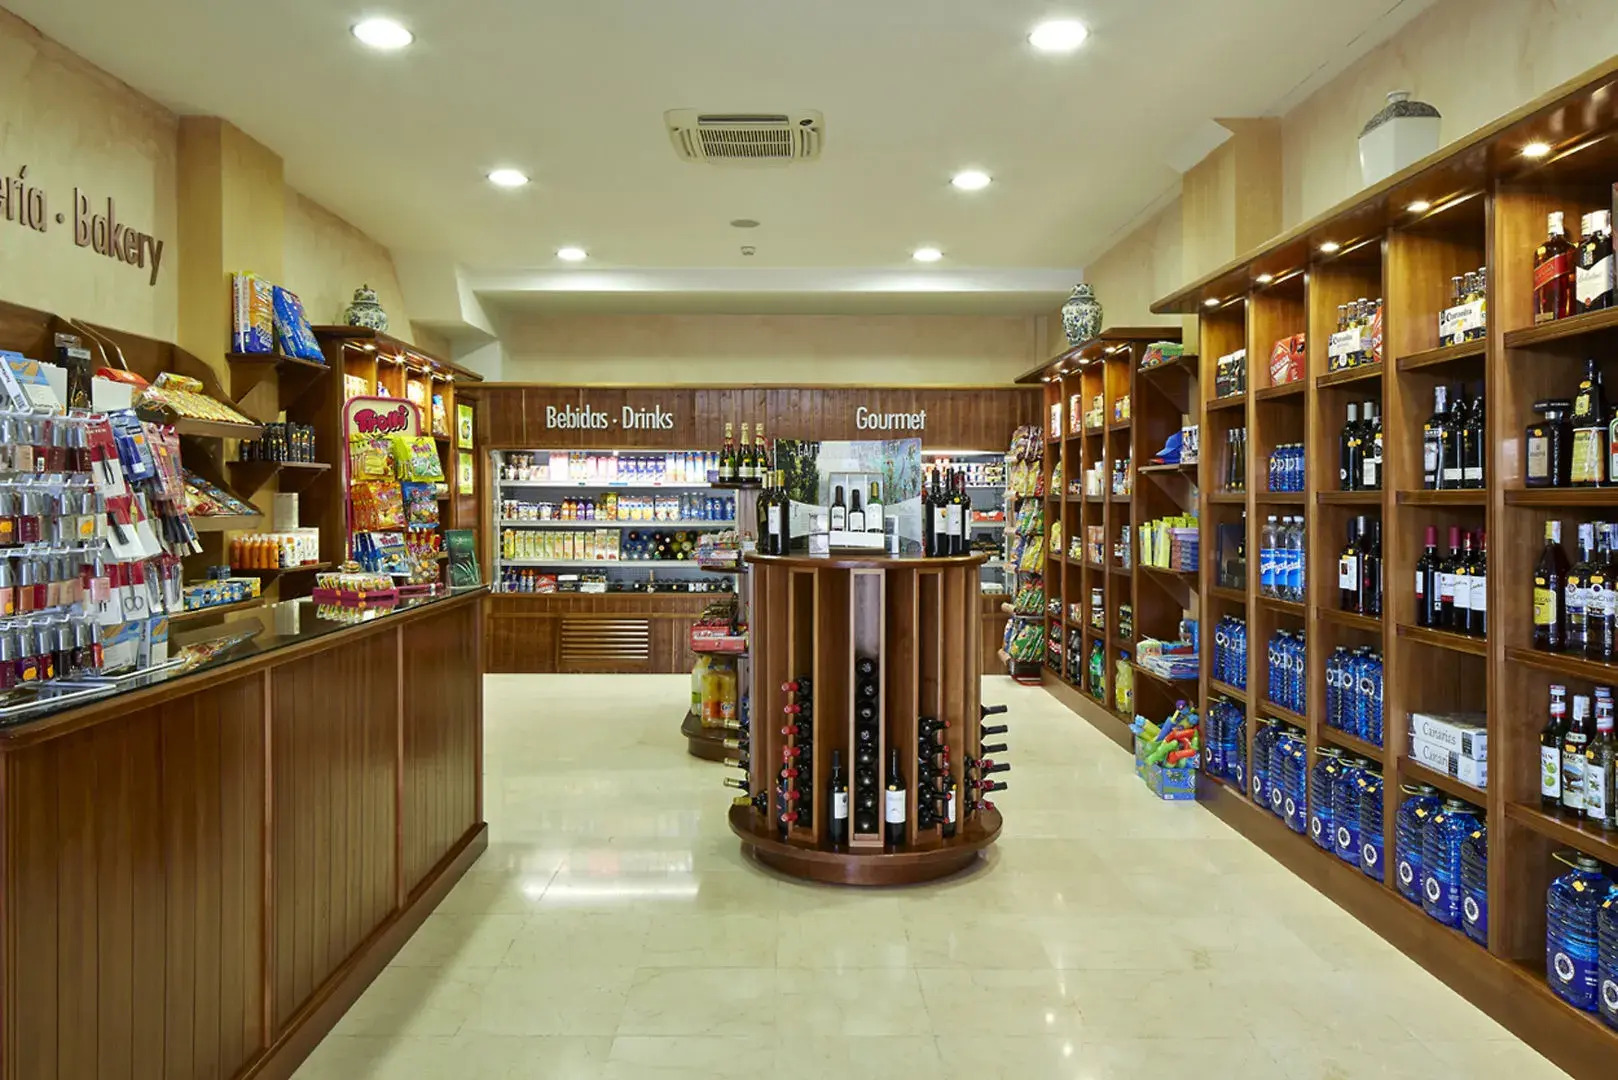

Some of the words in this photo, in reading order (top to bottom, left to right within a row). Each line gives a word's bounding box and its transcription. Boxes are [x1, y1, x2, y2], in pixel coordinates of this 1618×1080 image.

[74, 187, 164, 287] Bakery
[353, 404, 409, 434] Trolli
[545, 404, 609, 430] Bebidas
[622, 404, 674, 430] Drinks
[856, 406, 927, 430] Gourmet
